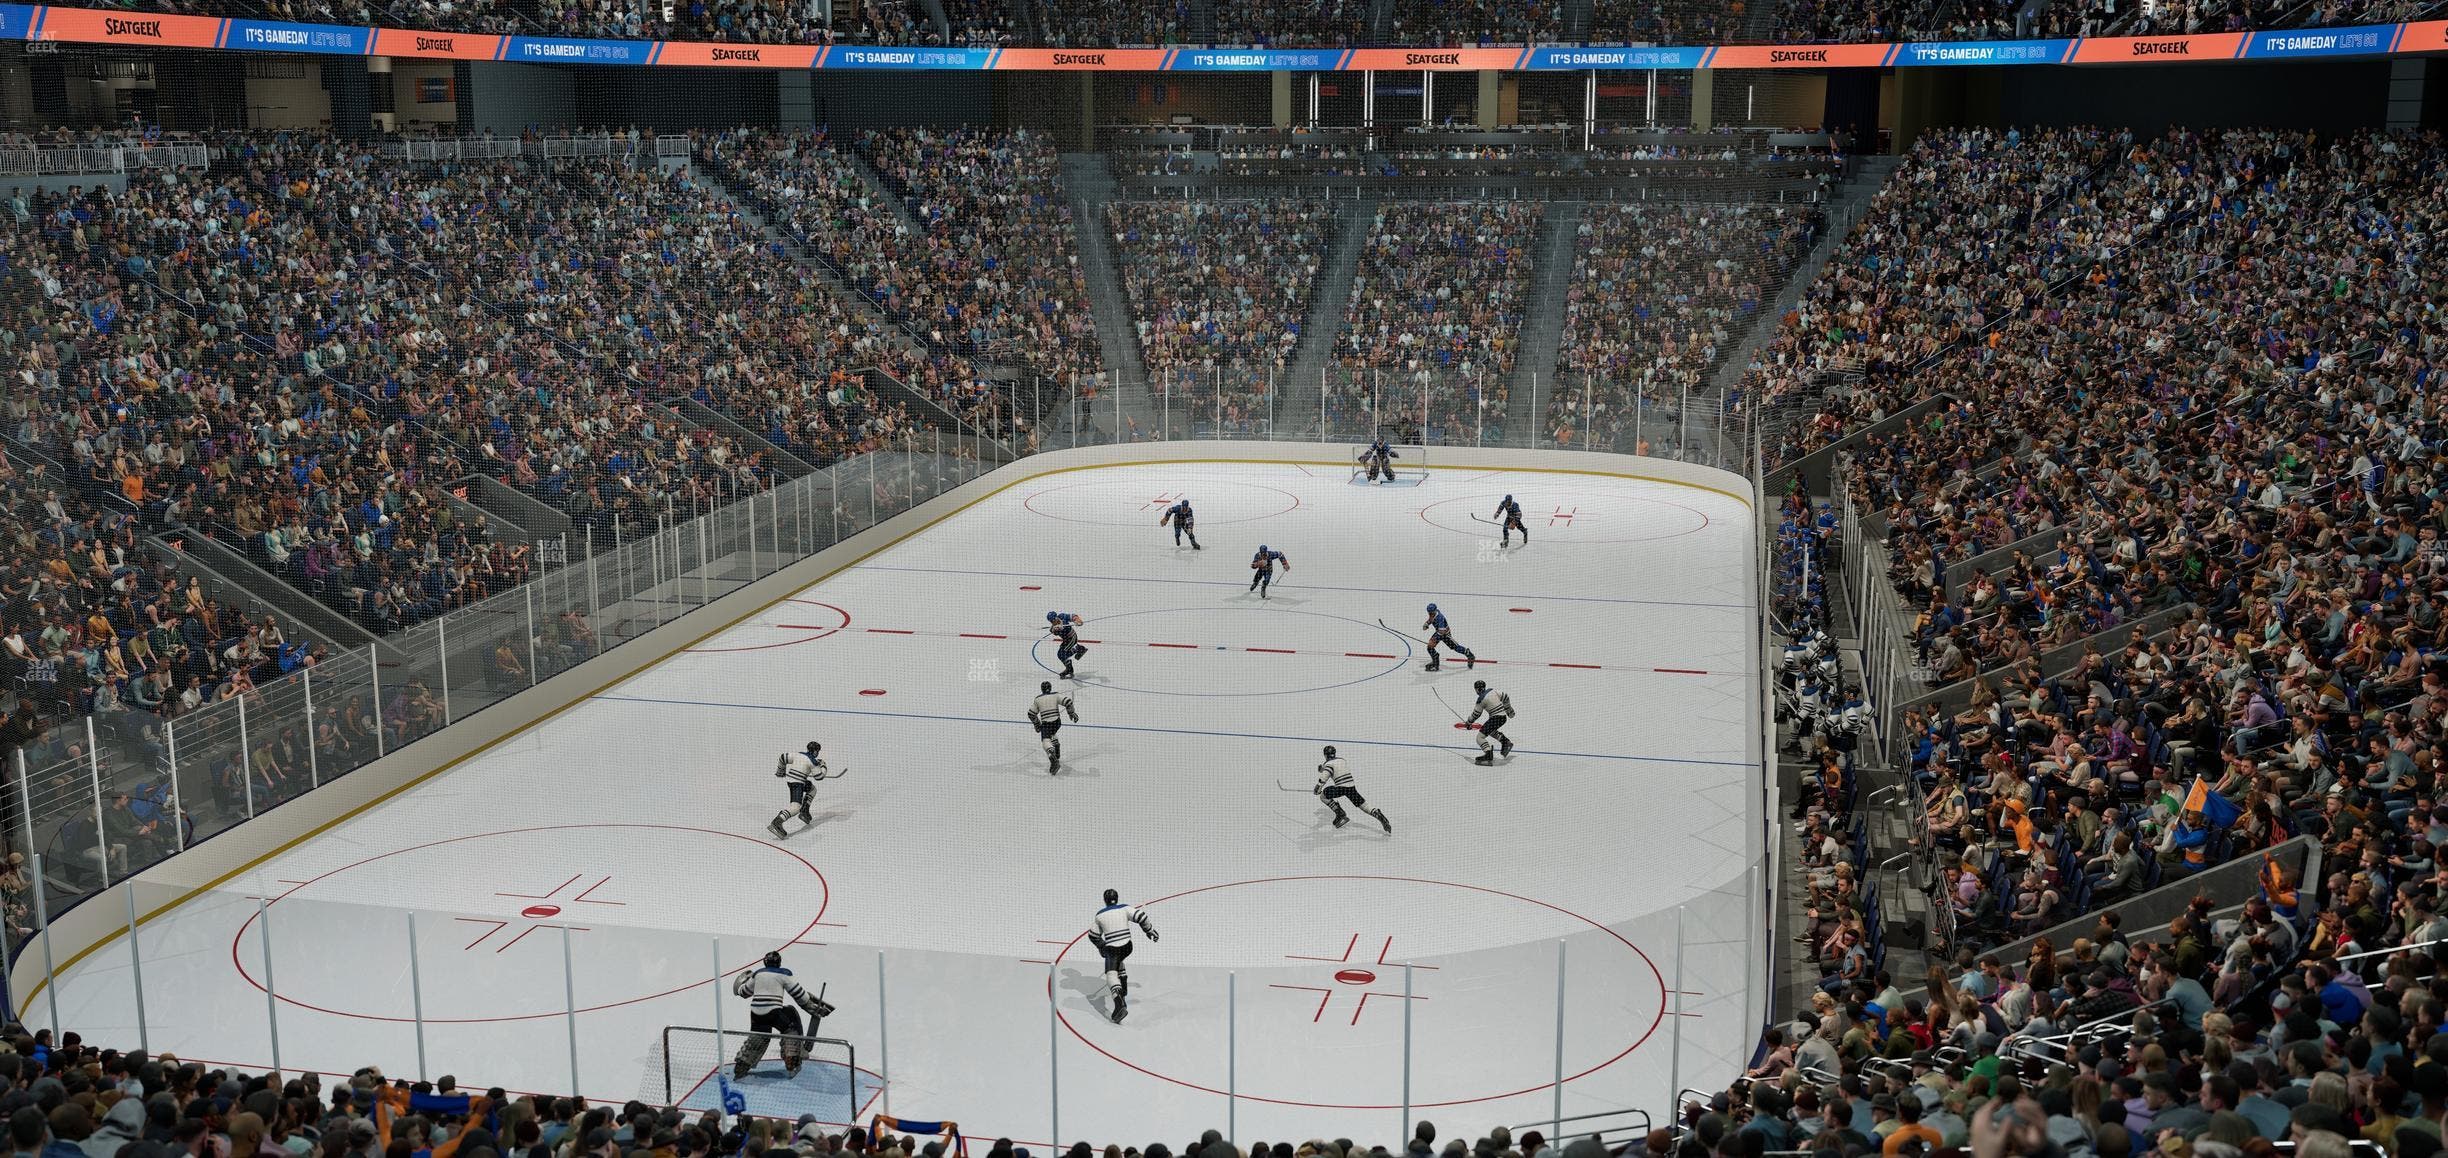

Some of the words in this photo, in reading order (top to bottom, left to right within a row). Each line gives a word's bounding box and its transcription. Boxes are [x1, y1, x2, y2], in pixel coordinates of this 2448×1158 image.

[105, 18, 162, 38] SEATGEEK
[245, 28, 264, 42] IT'S
[266, 29, 309, 45] GAMEDAY
[2267, 38, 2286, 51] IT'S
[2288, 35, 2336, 50] GAMEDAY
[416, 36, 454, 52] SEATGEEK
[524, 43, 542, 56] IT'S
[544, 44, 586, 57] GAMEDAY
[2133, 40, 2190, 56] SEATGEEK
[712, 48, 760, 62] SEATGEEK
[845, 52, 864, 63] IT'S
[867, 52, 914, 64] GAMEDAY
[1053, 53, 1106, 66] SEATGEEK
[1194, 54, 1214, 66] IT'S
[1216, 54, 1266, 66] GAMEDAY
[1406, 53, 1460, 65] SEATGEEK
[1550, 53, 1571, 64] IT'S
[1573, 53, 1625, 64] GAMEDAY
[1770, 50, 1828, 62] SEATGEEK
[1917, 49, 1938, 60] IT'S
[1940, 48, 1994, 60] GAMEDAY
